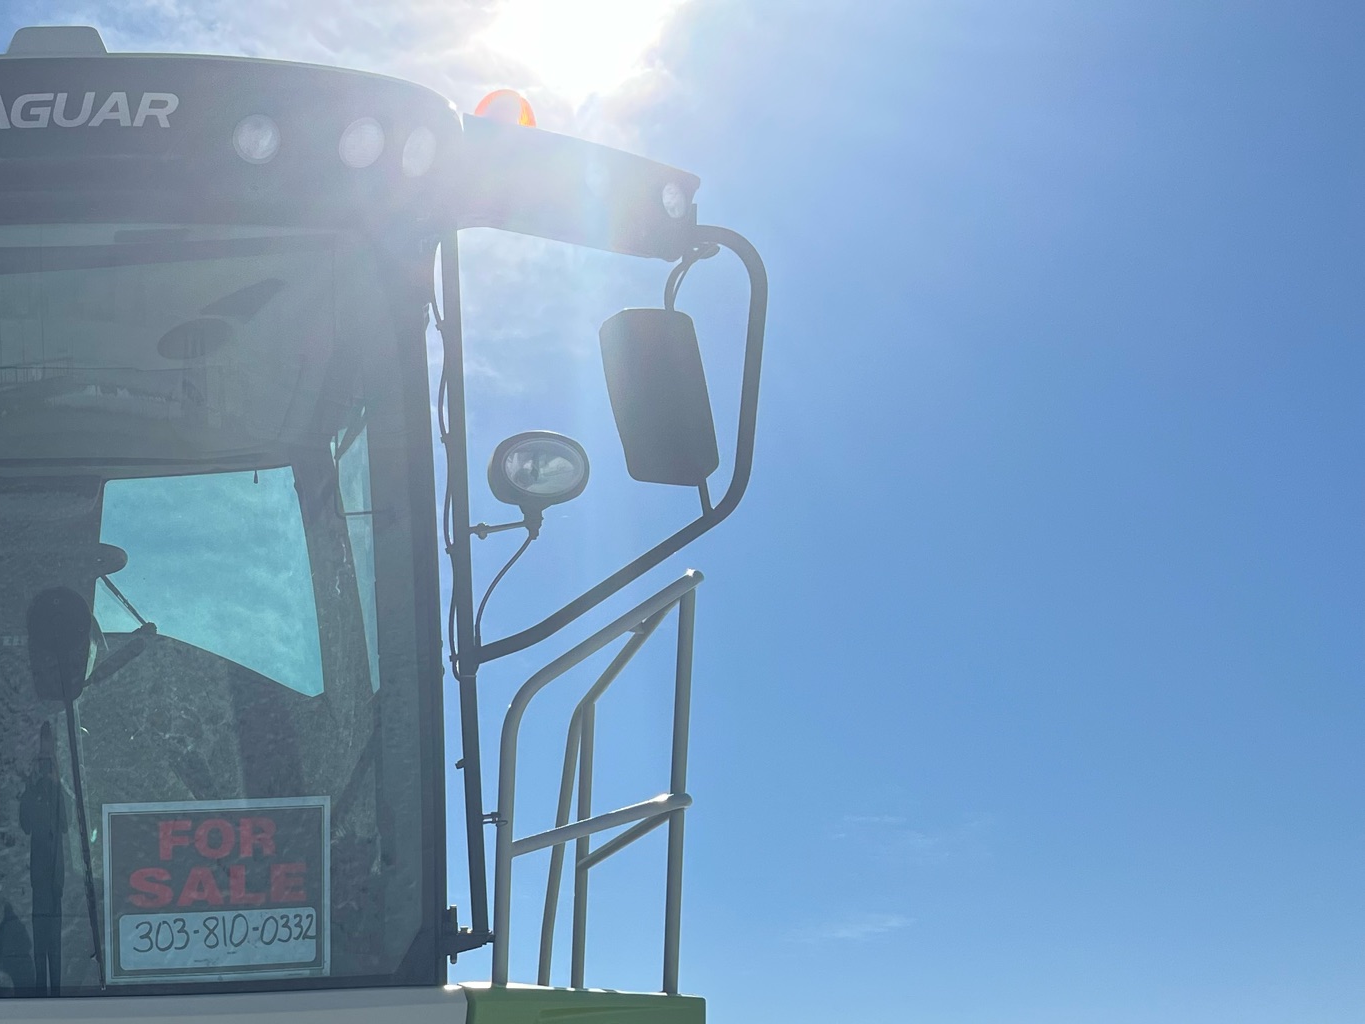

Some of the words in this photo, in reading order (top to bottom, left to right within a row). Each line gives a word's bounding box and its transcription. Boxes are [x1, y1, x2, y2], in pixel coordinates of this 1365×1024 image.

[158, 817, 277, 860] FOR
[127, 862, 307, 908] SALE
[133, 913, 317, 953] 303-810-0332
